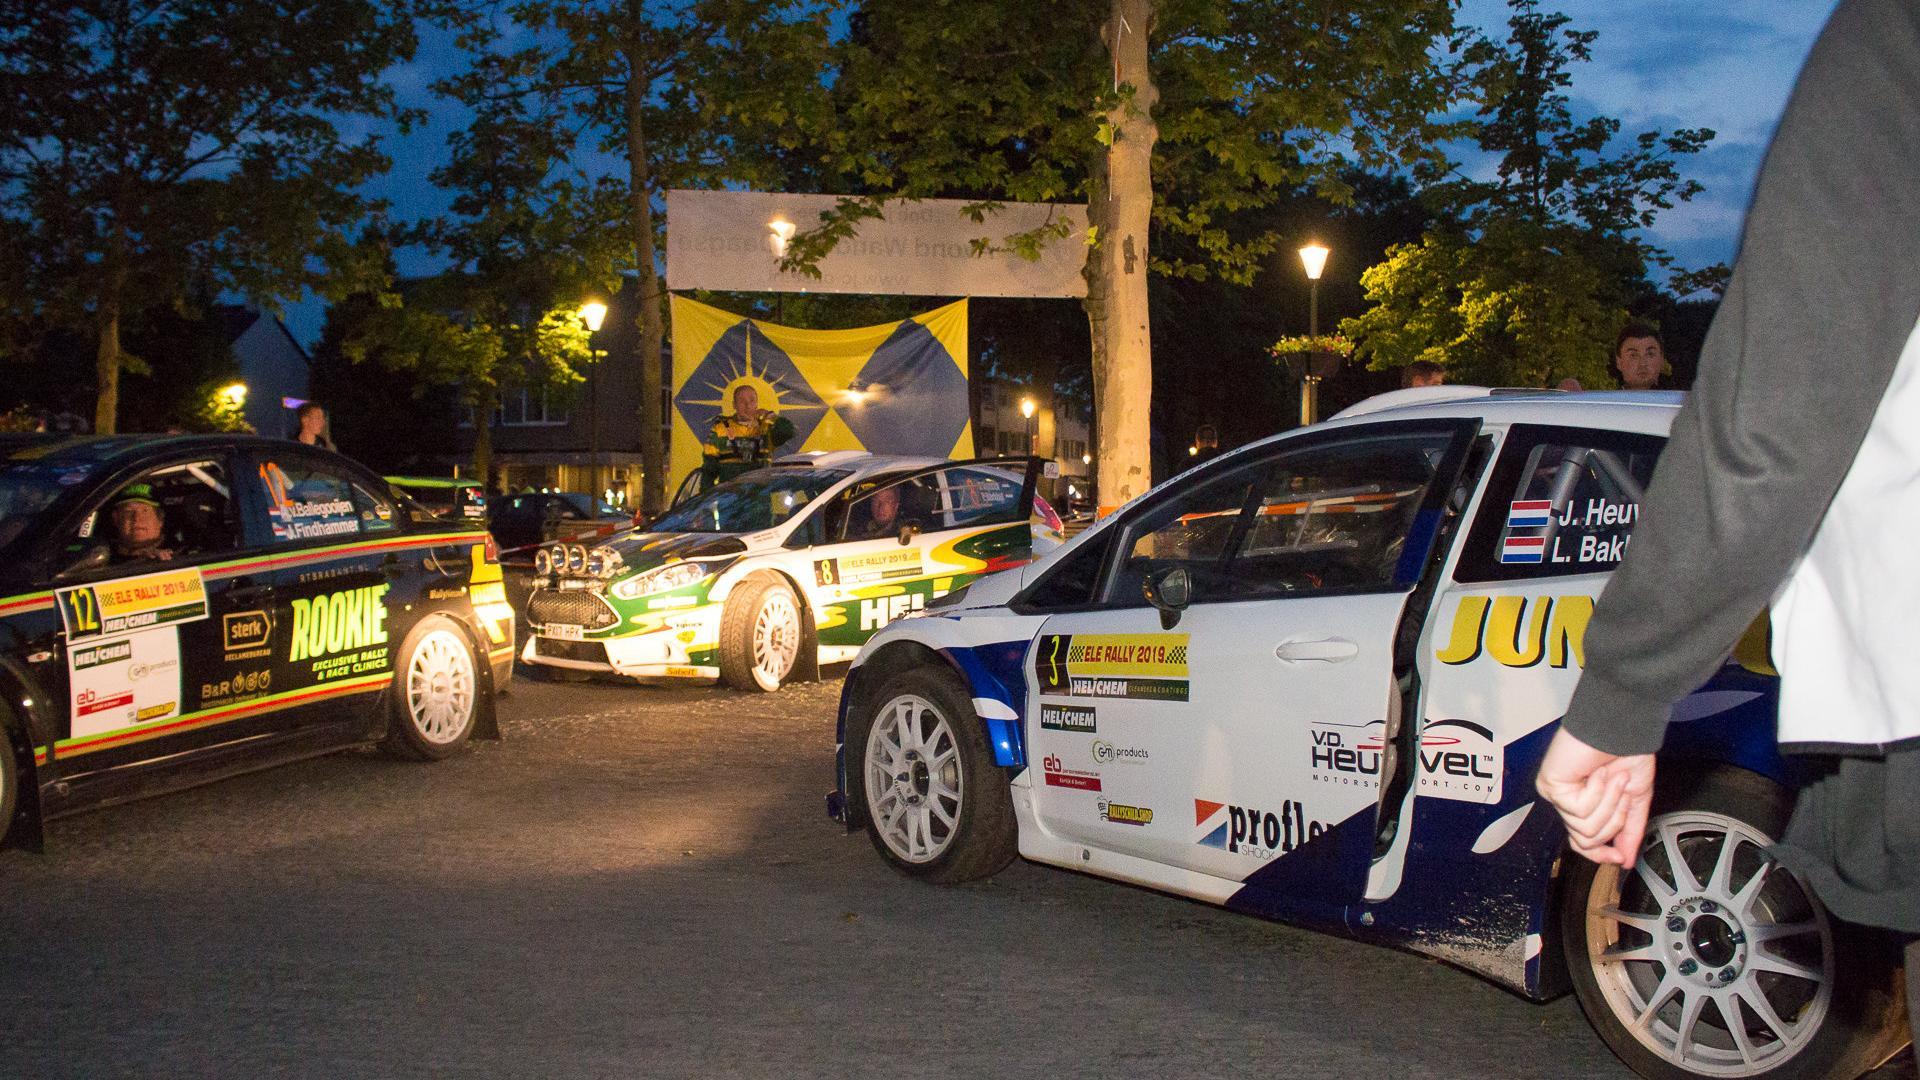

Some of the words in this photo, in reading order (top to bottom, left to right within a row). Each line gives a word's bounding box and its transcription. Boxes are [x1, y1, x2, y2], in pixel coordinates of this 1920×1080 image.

[1559, 500, 1578, 527] J.
[851, 559, 864, 568] ELE
[866, 557, 886, 566] RALLY
[889, 553, 908, 563] 2019
[1552, 536, 1571, 563] L.
[821, 559, 834, 584] 8
[115, 590, 133, 604] ELE
[135, 585, 160, 601] RALLY
[163, 581, 186, 594] 2019
[70, 587, 99, 632] 12
[231, 620, 262, 639] sterk
[289, 584, 389, 663] ROOKIE
[312, 653, 358, 672] EXCLUSIVE
[360, 647, 388, 662] RALLY
[1049, 634, 1060, 686] 3
[1084, 646, 1102, 662] ELE
[1104, 646, 1136, 663] RALLY
[1137, 646, 1166, 664] 2019
[326, 666, 350, 680] RACE
[353, 658, 387, 673] CLINICS
[77, 688, 96, 705] eb
[1312, 729, 1344, 748] V.D.
[1043, 753, 1062, 772] eb
[1116, 746, 1149, 758] products
[1241, 843, 1275, 861] SHOCK
